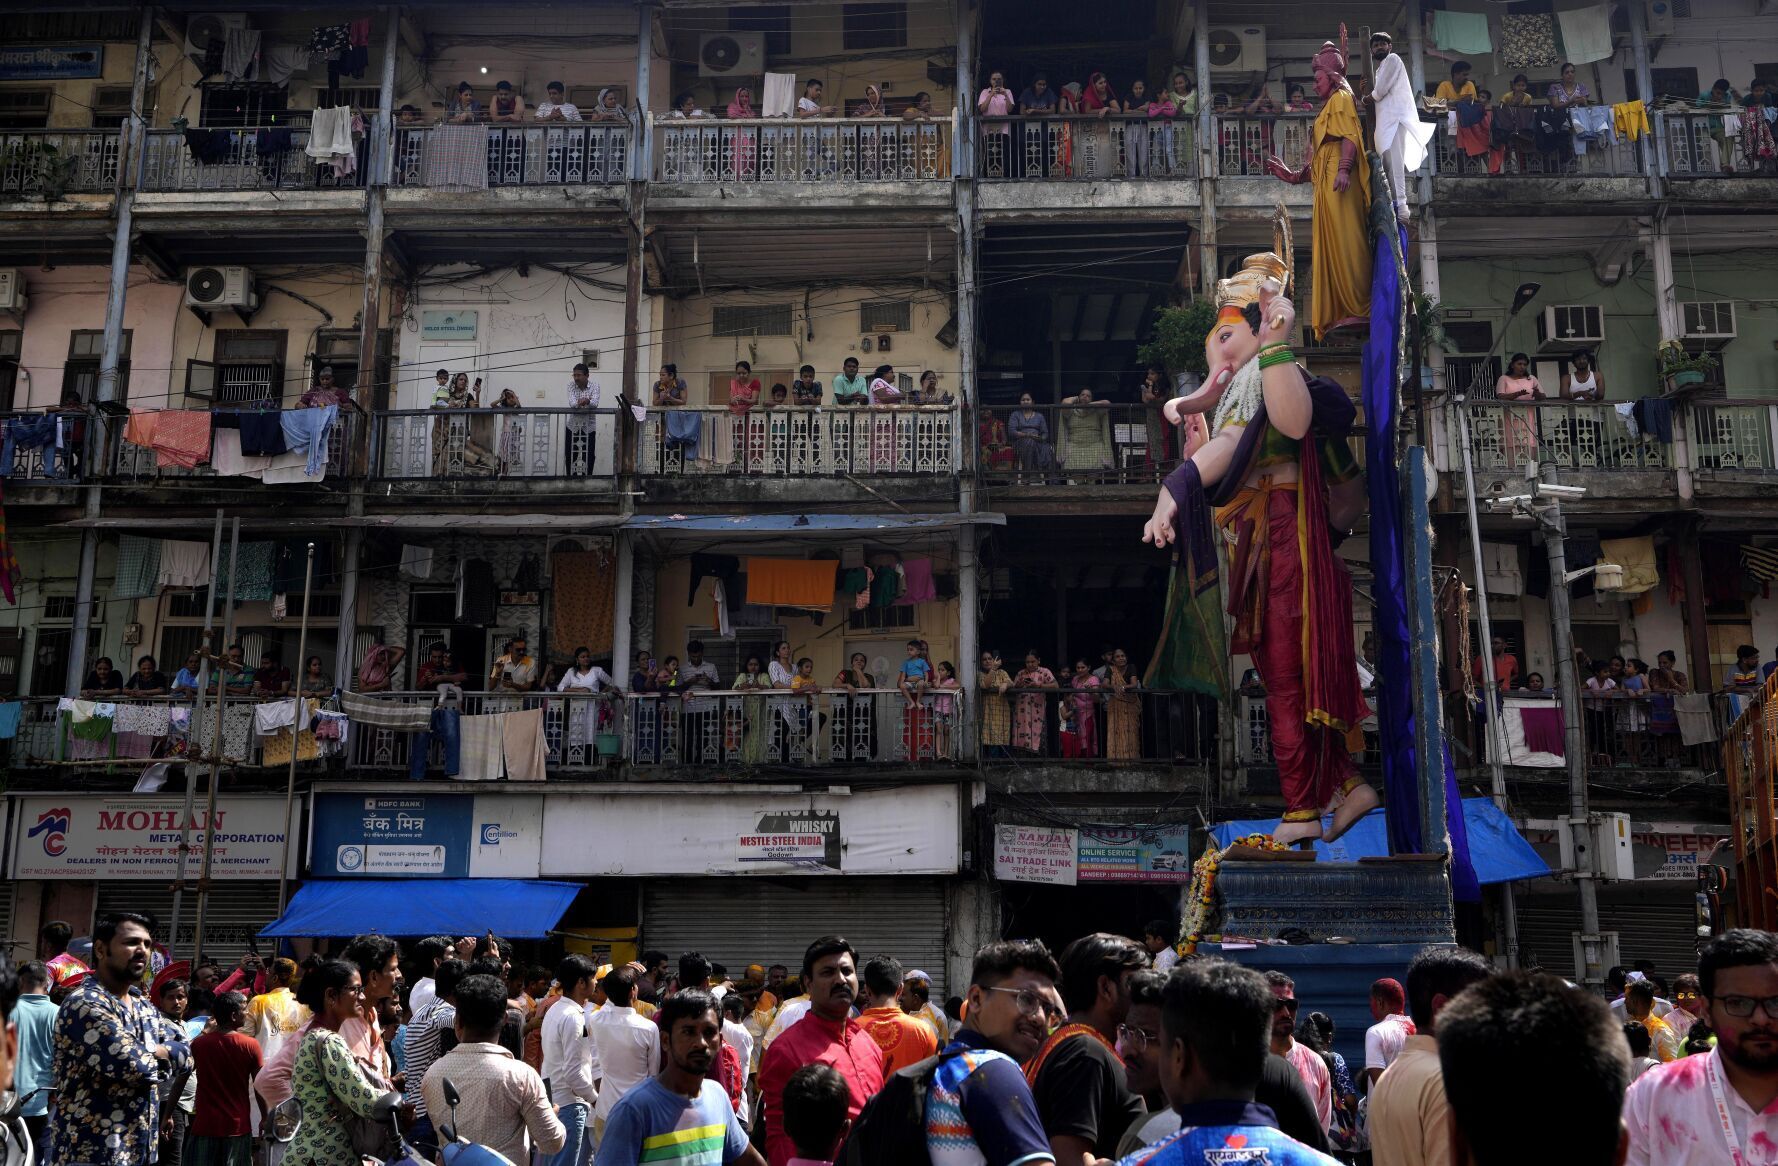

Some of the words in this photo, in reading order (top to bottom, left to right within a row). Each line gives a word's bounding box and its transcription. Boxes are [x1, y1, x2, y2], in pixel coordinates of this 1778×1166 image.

[97, 811, 226, 831] MOHAN
[363, 812, 390, 831] बँक
[396, 812, 425, 831] मित्र
[789, 820, 835, 833] WHISKY
[150, 834, 189, 843] META
[196, 834, 285, 843] CRPORATION
[740, 837, 770, 846] NESTLE
[772, 837, 796, 846] STEEL
[798, 837, 822, 846] INDIA
[1108, 849, 1137, 857] SERVICE
[999, 855, 1014, 863] SAI
[1017, 857, 1047, 865] TRADE
[1050, 859, 1072, 867] LINK
